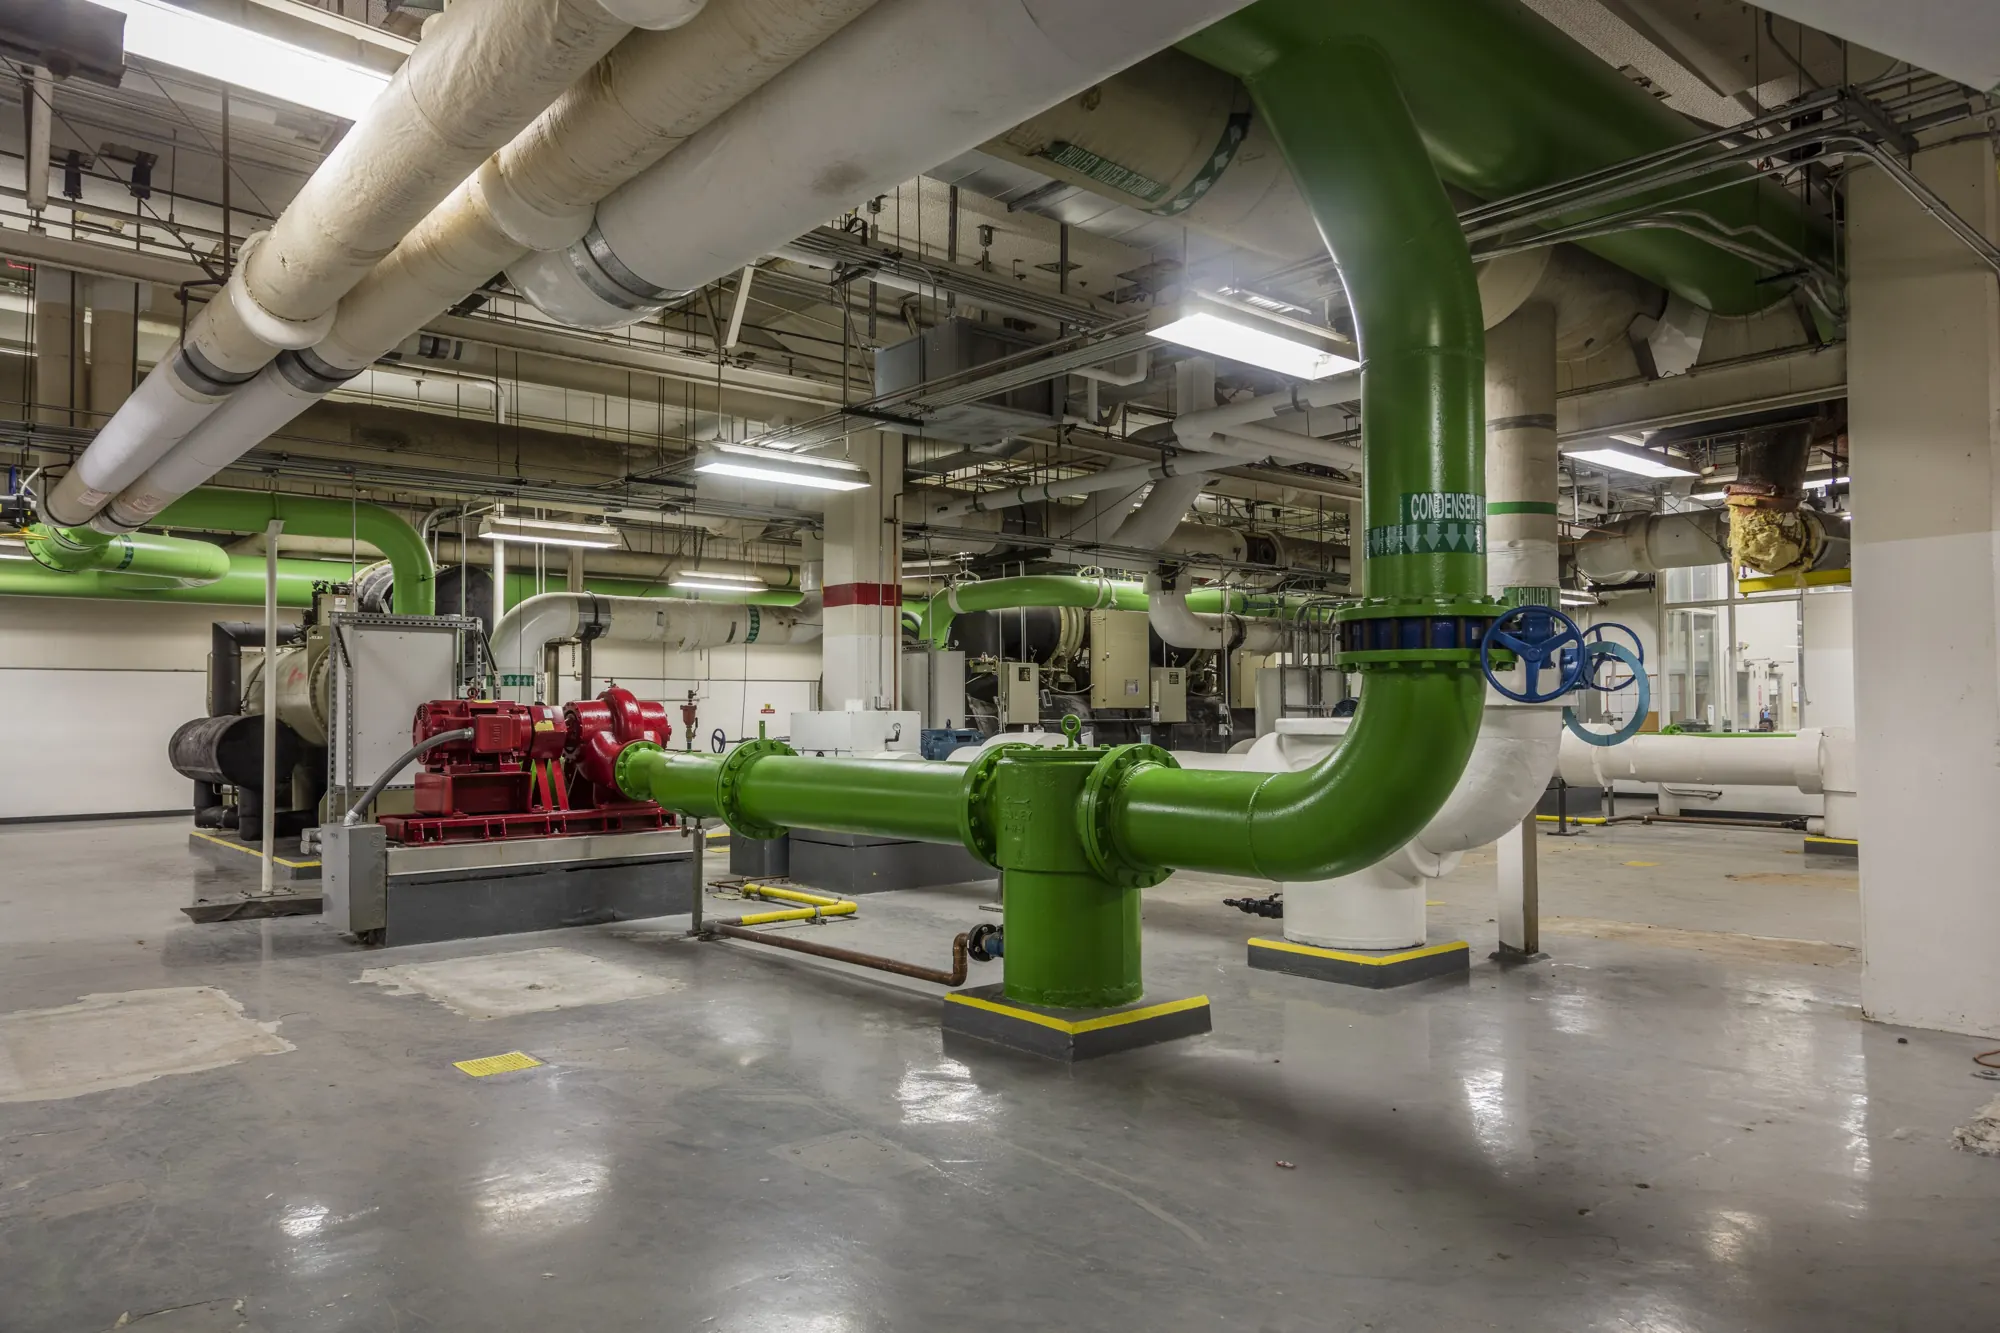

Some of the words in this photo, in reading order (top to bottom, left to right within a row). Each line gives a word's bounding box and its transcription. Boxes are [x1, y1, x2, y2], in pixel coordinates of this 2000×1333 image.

[1054, 145, 1100, 173] CHILLED
[1090, 160, 1129, 186] WATER
[1411, 492, 1476, 521] CONDENSER
[1518, 587, 1549, 607] CHILLED
